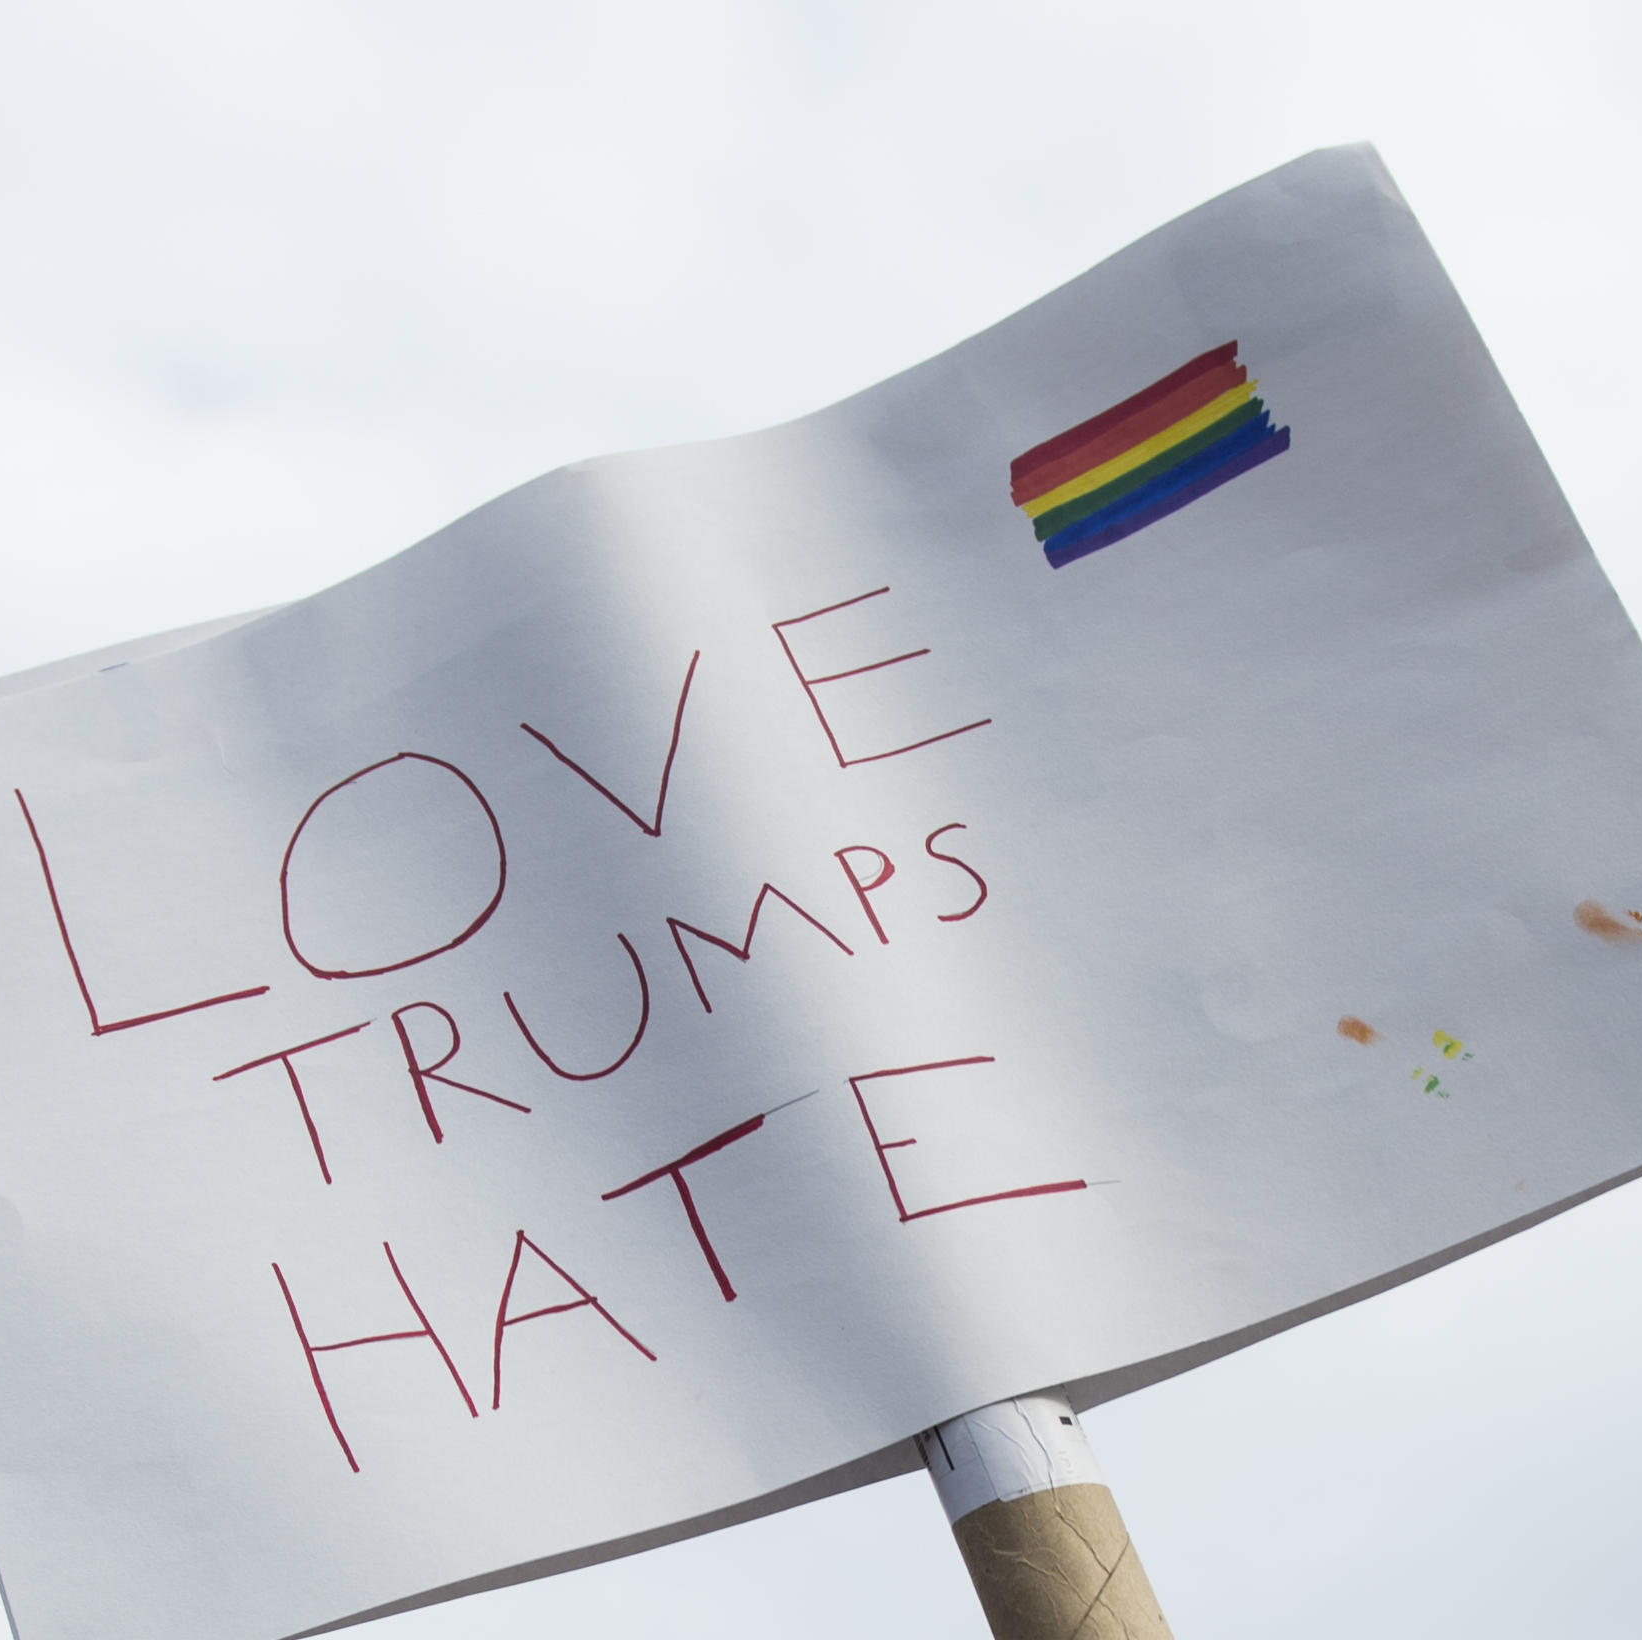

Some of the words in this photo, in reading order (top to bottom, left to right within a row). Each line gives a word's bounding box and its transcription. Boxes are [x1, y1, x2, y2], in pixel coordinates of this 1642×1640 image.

[14, 587, 993, 1038] LOVE
[212, 822, 989, 1187] TRUMPS
[271, 1055, 1090, 1475] HATE
